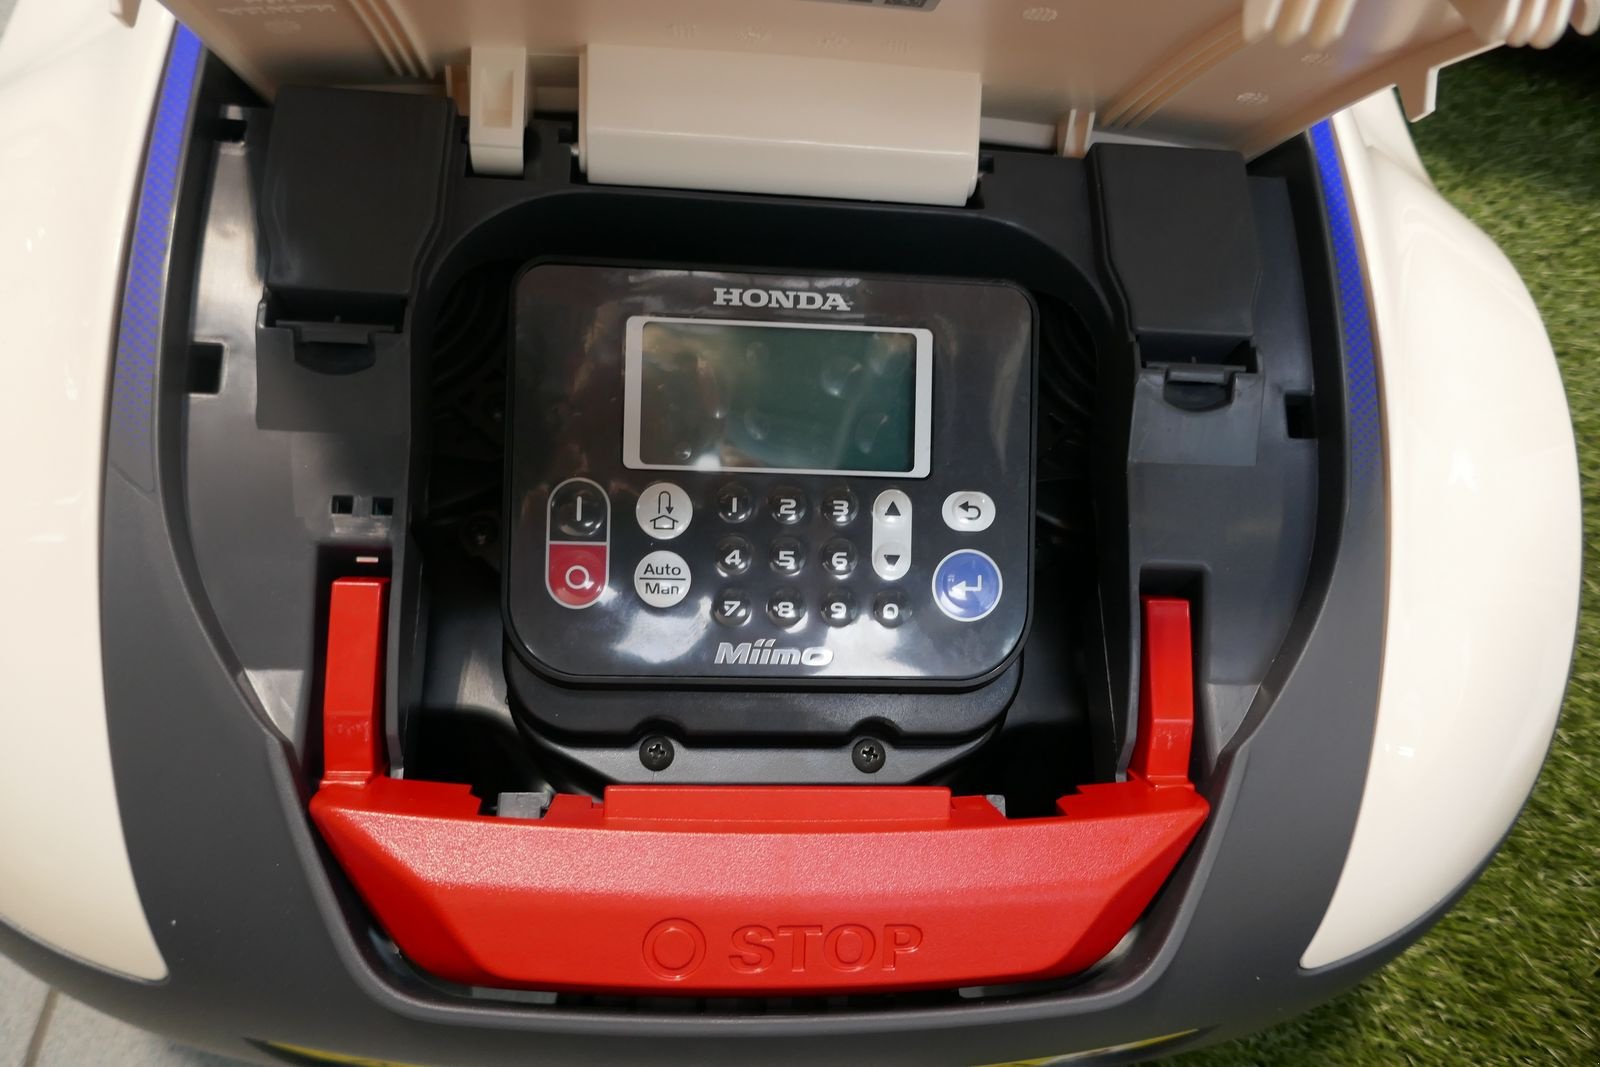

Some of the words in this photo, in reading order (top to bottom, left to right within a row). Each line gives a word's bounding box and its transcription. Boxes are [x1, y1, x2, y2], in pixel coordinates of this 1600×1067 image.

[713, 287, 851, 311] HONDA
[731, 497, 738, 513] 1
[780, 498, 797, 515] 2
[832, 500, 849, 516] 3
[725, 549, 742, 566] 4
[778, 550, 795, 567] 5
[831, 552, 848, 569] 6
[643, 562, 682, 577] Auto
[645, 582, 680, 596] Man
[724, 601, 741, 617] 7
[777, 601, 795, 618] 8
[830, 602, 847, 619] 9
[714, 638, 834, 666] Miimo
[728, 923, 924, 974] STOP
